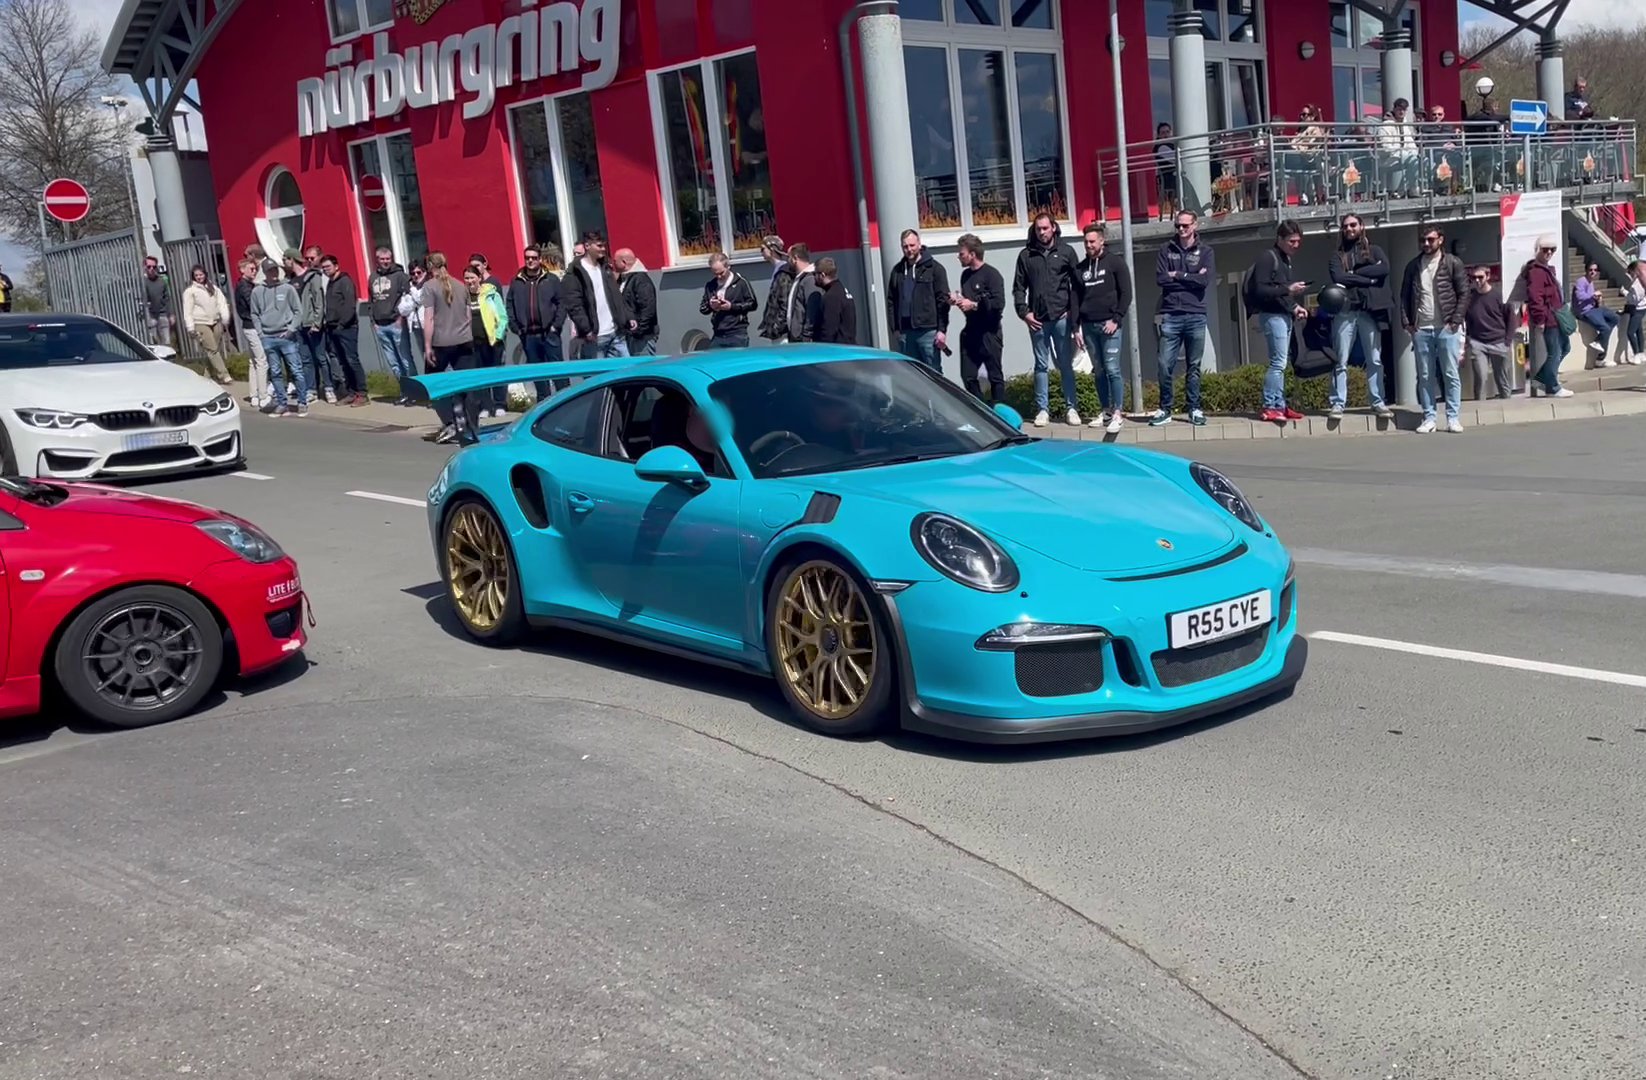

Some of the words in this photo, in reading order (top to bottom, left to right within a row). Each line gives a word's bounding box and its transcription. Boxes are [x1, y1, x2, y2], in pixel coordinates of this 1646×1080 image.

[297, 0, 621, 137] nürburgring
[268, 582, 286, 597] LITE
[1187, 608, 1224, 640] R55
[1229, 597, 1260, 628] CYE
